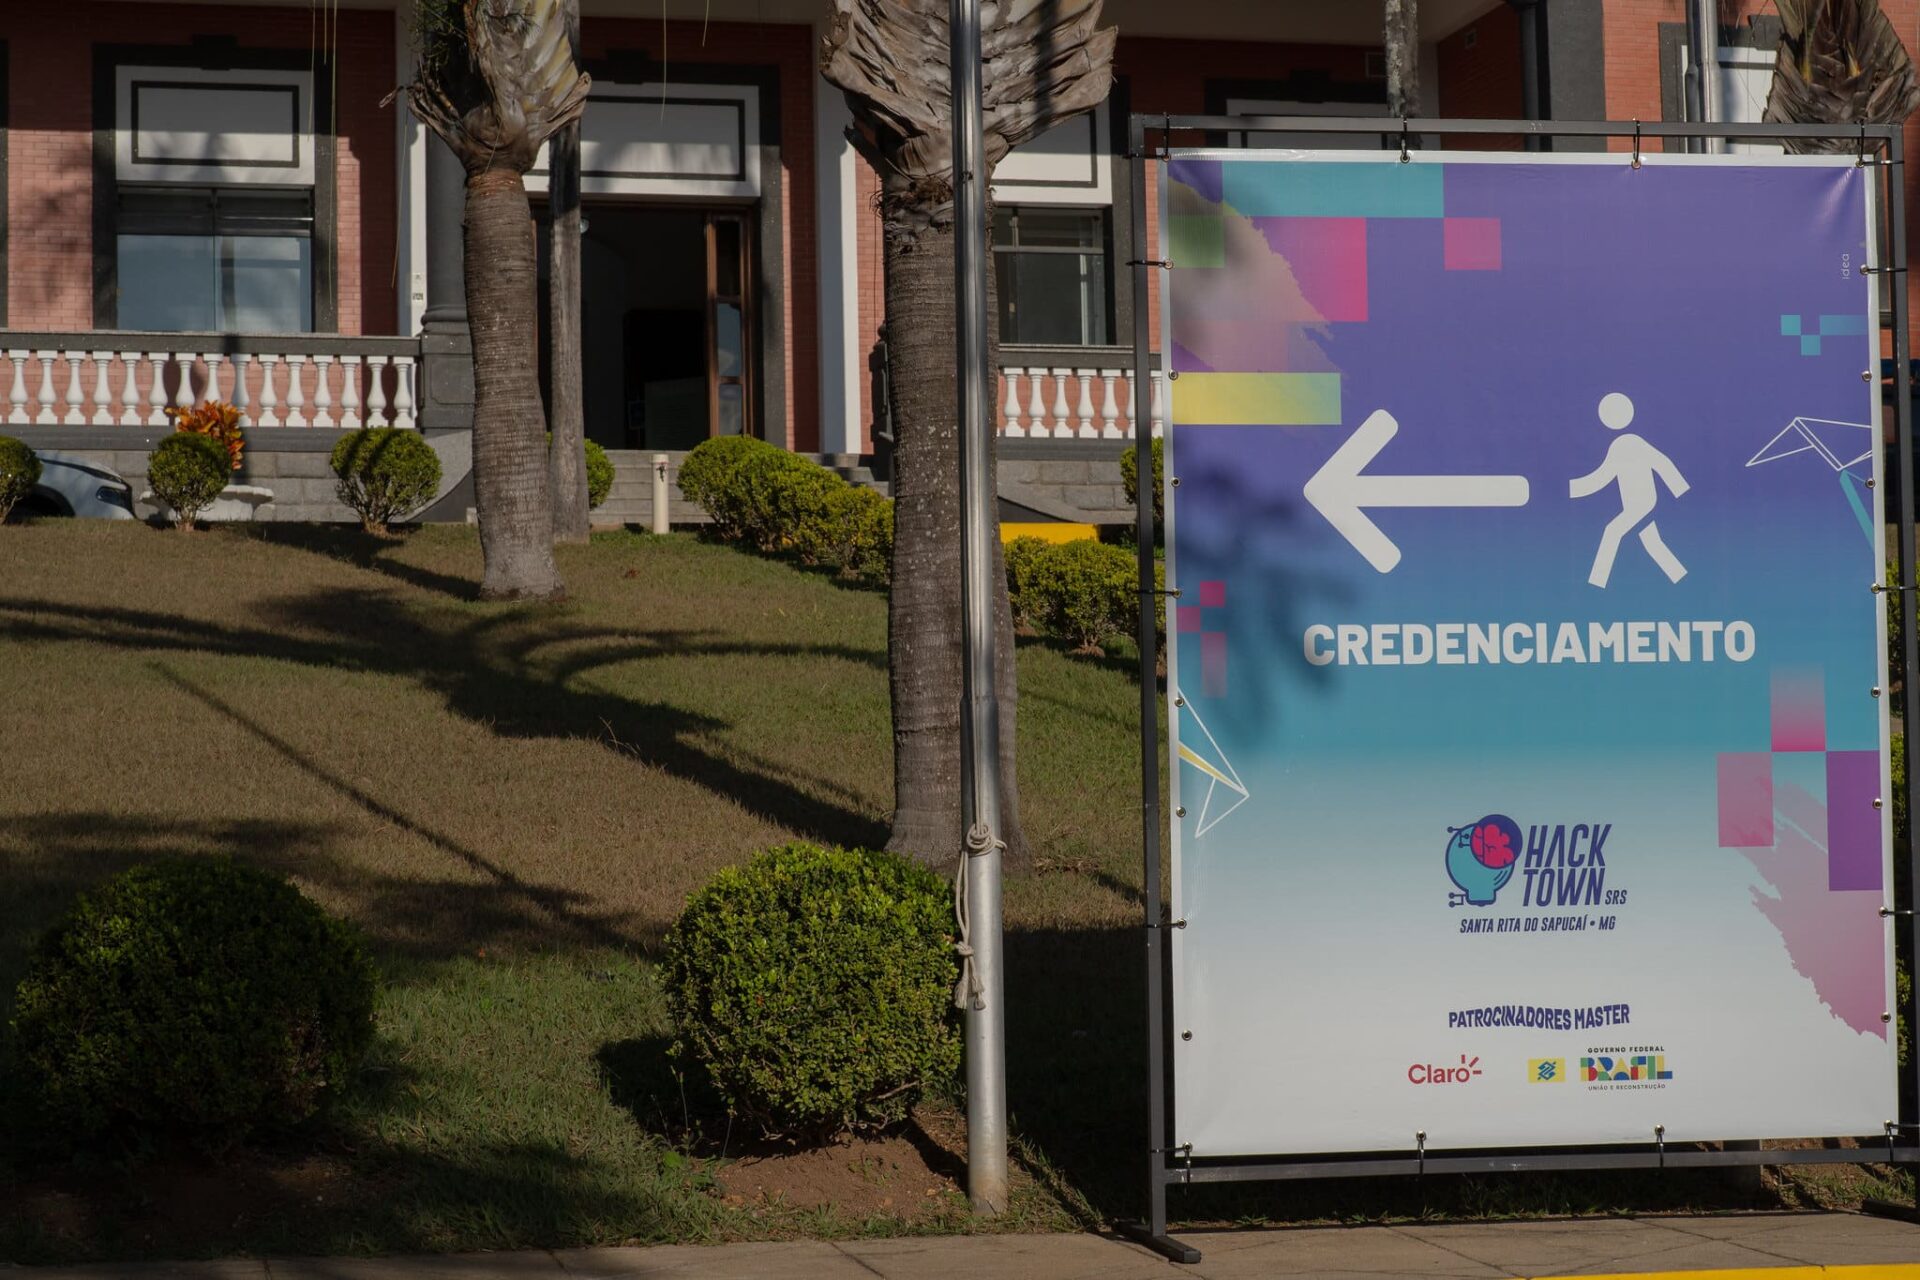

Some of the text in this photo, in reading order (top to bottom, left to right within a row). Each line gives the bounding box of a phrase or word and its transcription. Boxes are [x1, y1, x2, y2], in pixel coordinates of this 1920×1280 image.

[1303, 620, 1756, 666] CREDENCIAMENTO
[1524, 823, 1612, 867] HACK
[1522, 867, 1628, 907] TOWN SRS
[1459, 914, 1616, 933] SANTA RITA DO SAPUCAÍ MG
[1448, 1003, 1630, 1031] PATROCINADORES MASTER
[1587, 1045, 1665, 1054] GOVERNO FEDERAL
[1407, 1063, 1471, 1085] Claro
[1580, 1054, 1673, 1082] BRASIL
[1588, 1083, 1608, 1091] UNIÃO
[1616, 1083, 1666, 1091] RECONSTRUÇÃO
